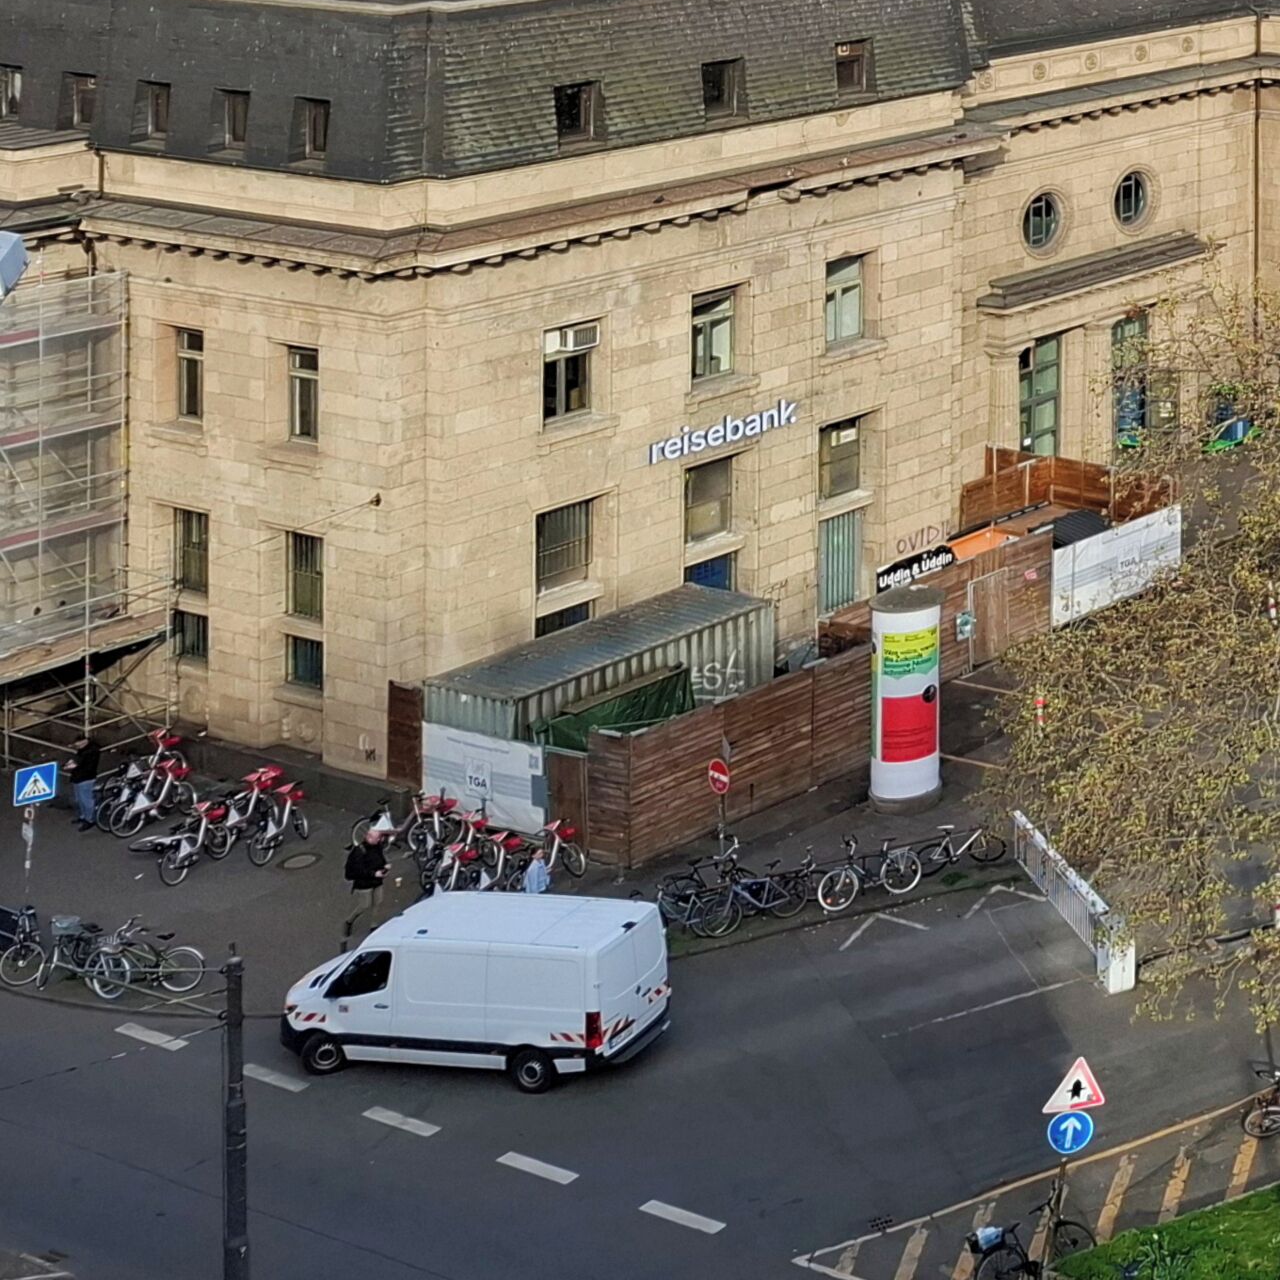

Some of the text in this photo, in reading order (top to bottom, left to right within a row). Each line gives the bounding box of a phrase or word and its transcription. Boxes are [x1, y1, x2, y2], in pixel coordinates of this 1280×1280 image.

[649, 399, 797, 464] reisebank
[912, 563, 920, 576] &
[468, 775, 488, 789] TGA
